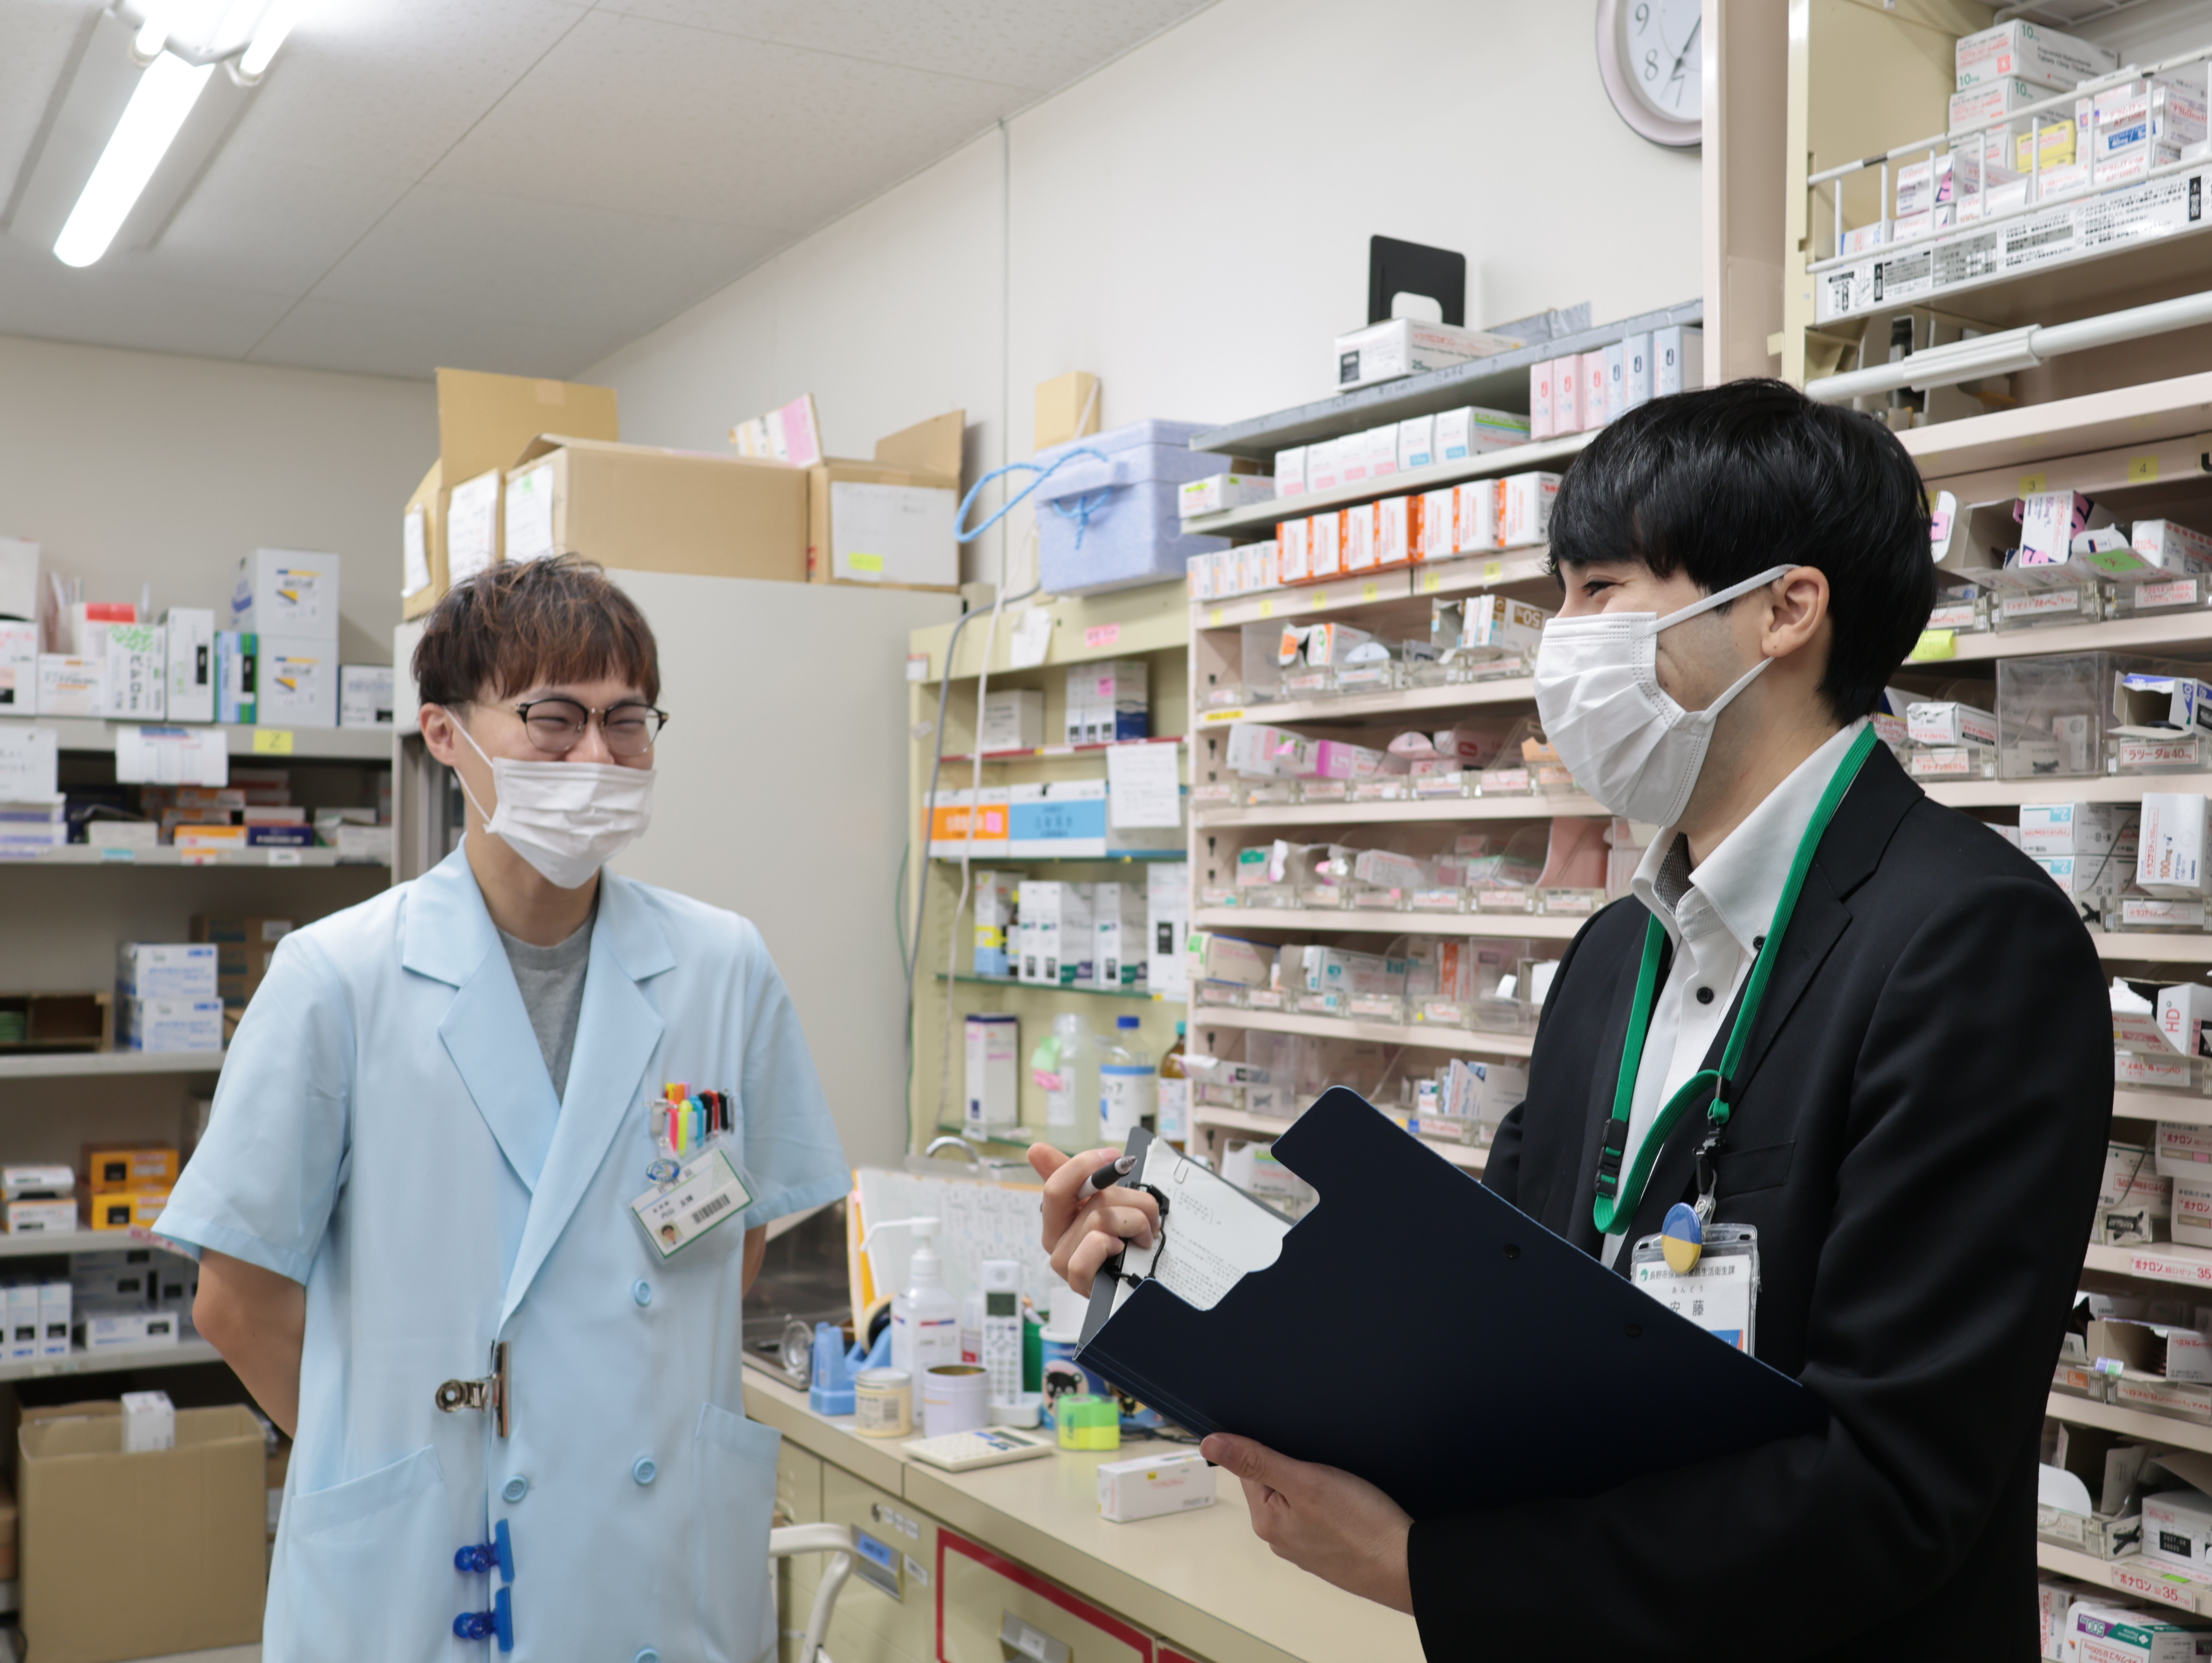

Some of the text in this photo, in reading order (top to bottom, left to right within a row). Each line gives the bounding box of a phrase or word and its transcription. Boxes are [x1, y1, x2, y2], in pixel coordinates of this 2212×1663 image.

[1635, 3, 1650, 37] 9
[1644, 48, 1658, 81] 8
[2139, 463, 2147, 473] 4
[2029, 481, 2036, 491] 3
[2165, 1008, 2180, 1033] HD
[1670, 1300, 1705, 1317] 安藤
